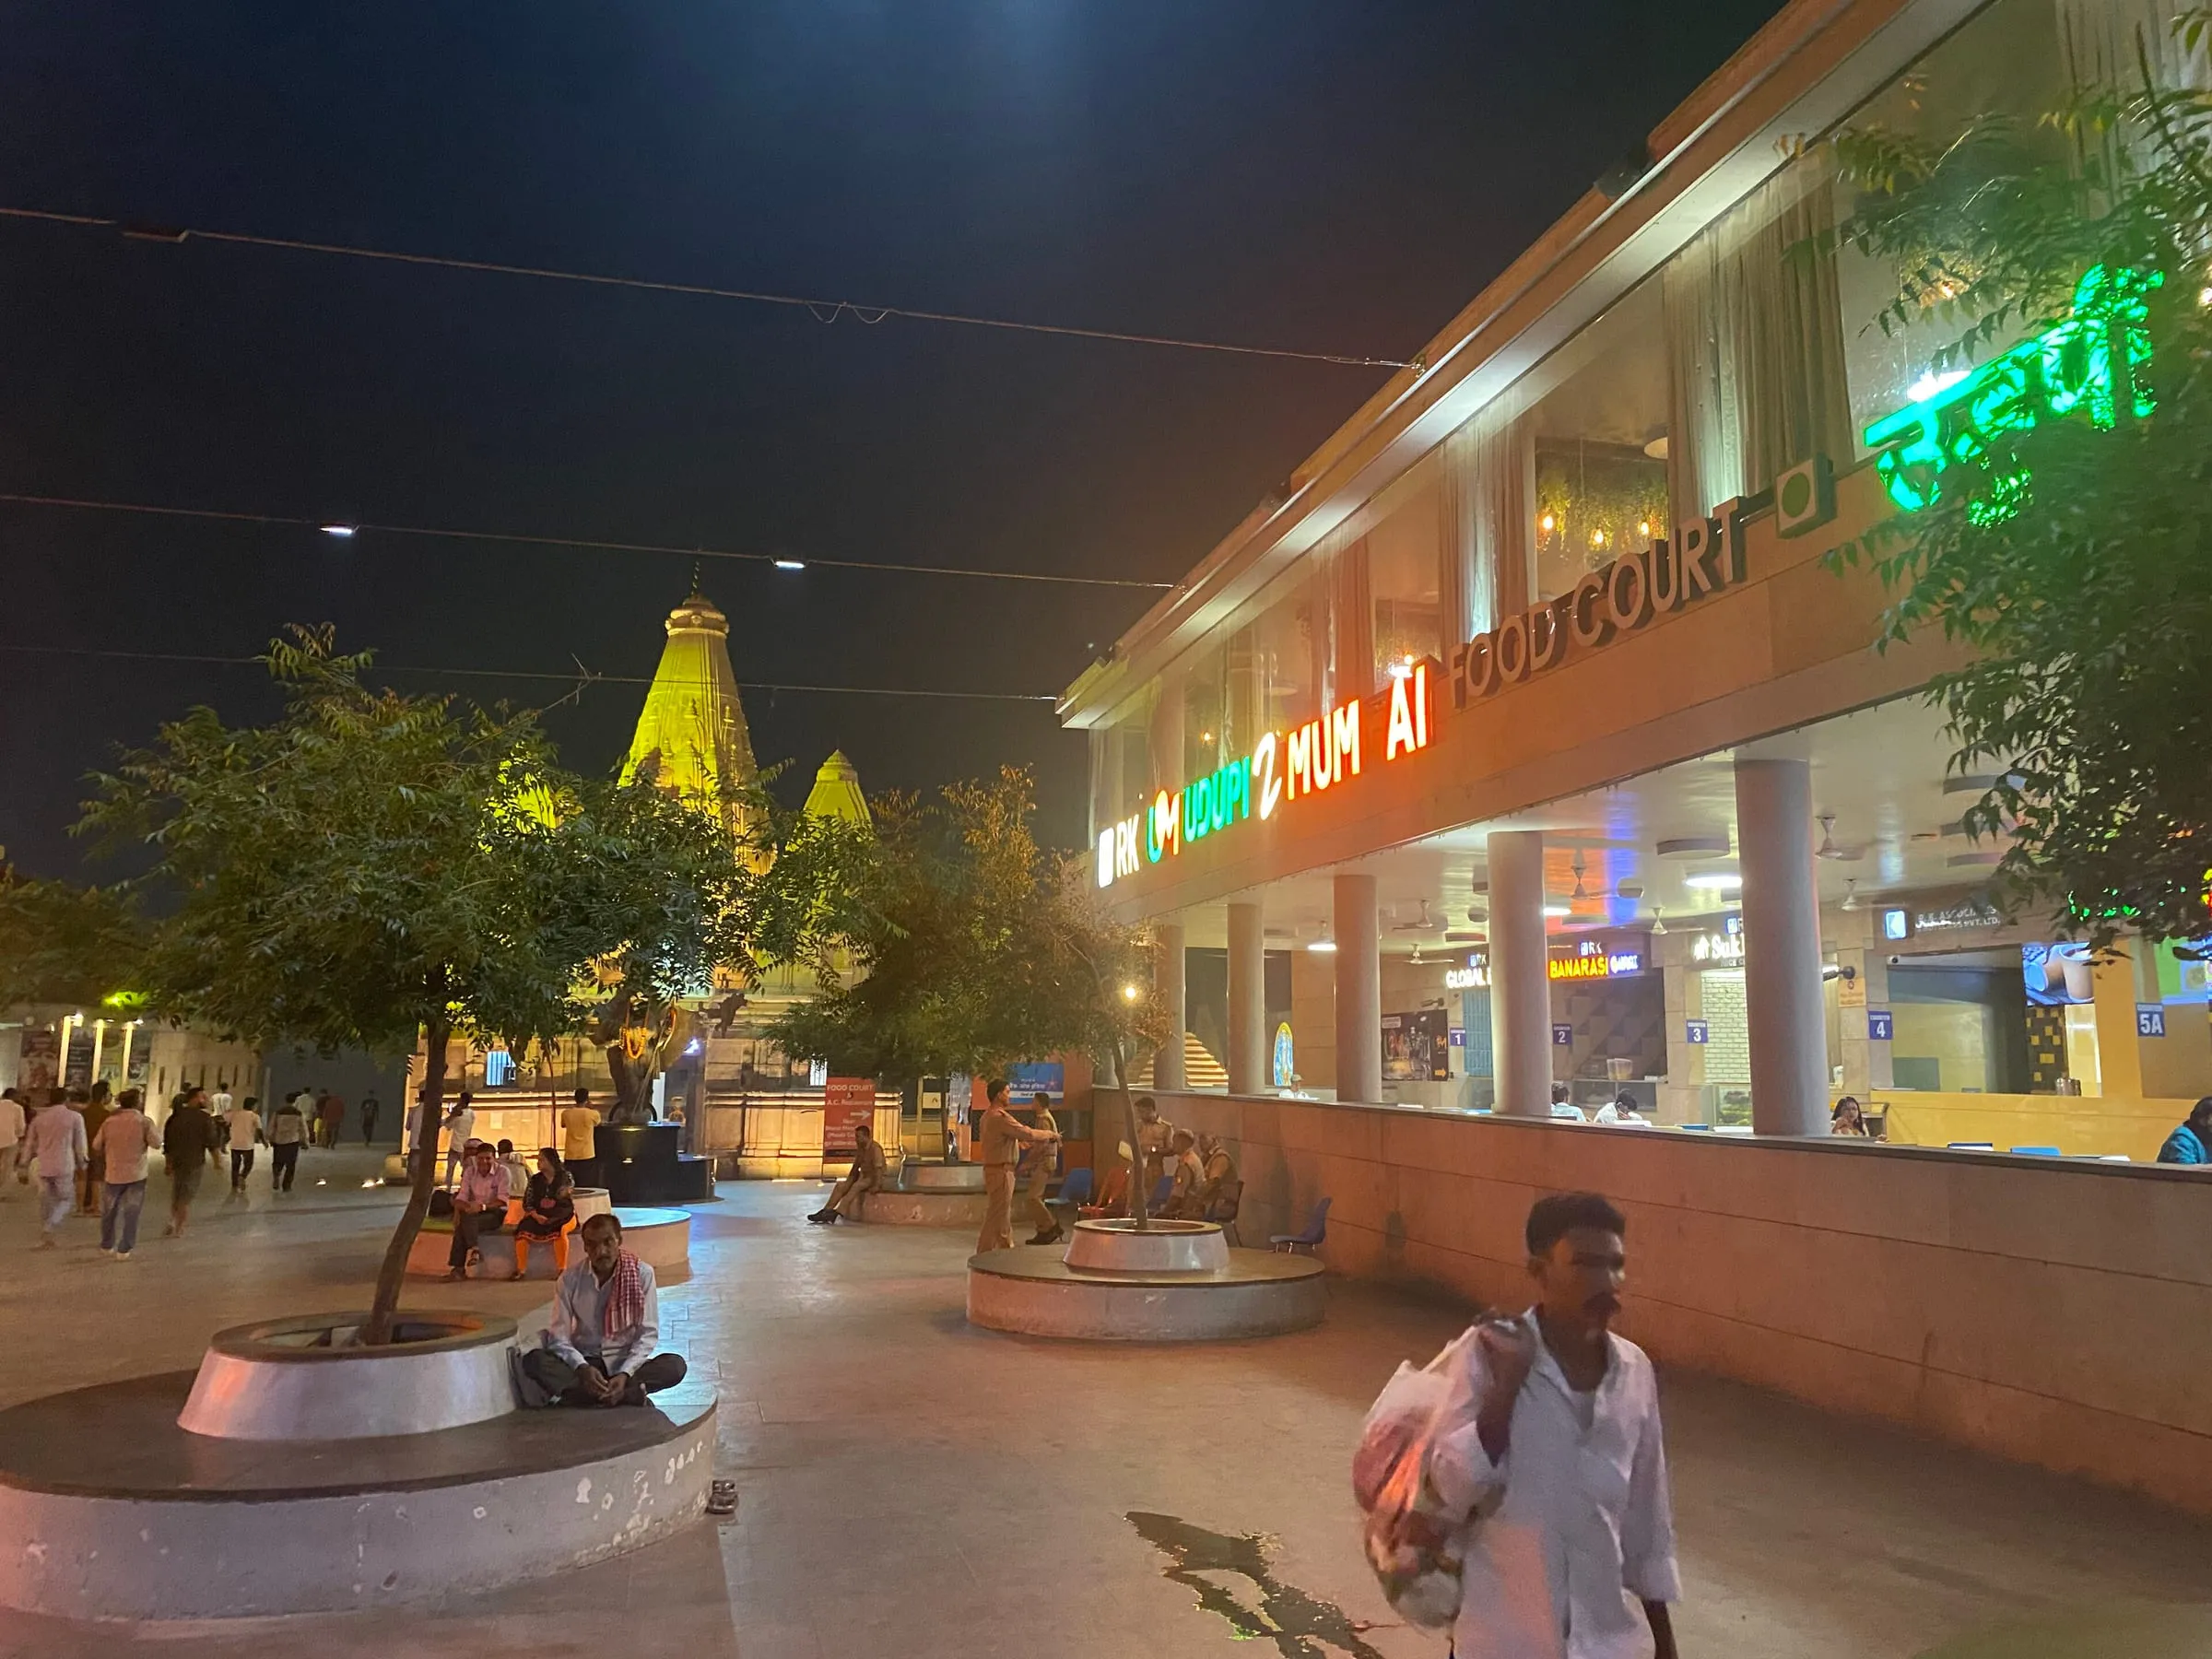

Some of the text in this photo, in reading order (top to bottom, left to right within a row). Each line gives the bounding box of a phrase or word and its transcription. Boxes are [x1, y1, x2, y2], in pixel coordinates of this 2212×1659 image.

[1448, 497, 1743, 710] FOOD COURT
[1116, 814, 1140, 878] RK
[1183, 756, 1250, 842] UDUPI
[1550, 957, 1608, 978] BANARASI
[1446, 968, 1486, 988] GLOBAL
[1877, 1021, 1886, 1038] 4
[2140, 1014, 2163, 1033] 5A
[1454, 1033, 1461, 1044] 1
[1558, 1031, 1566, 1042] 2
[1693, 1028, 1701, 1041] 3
